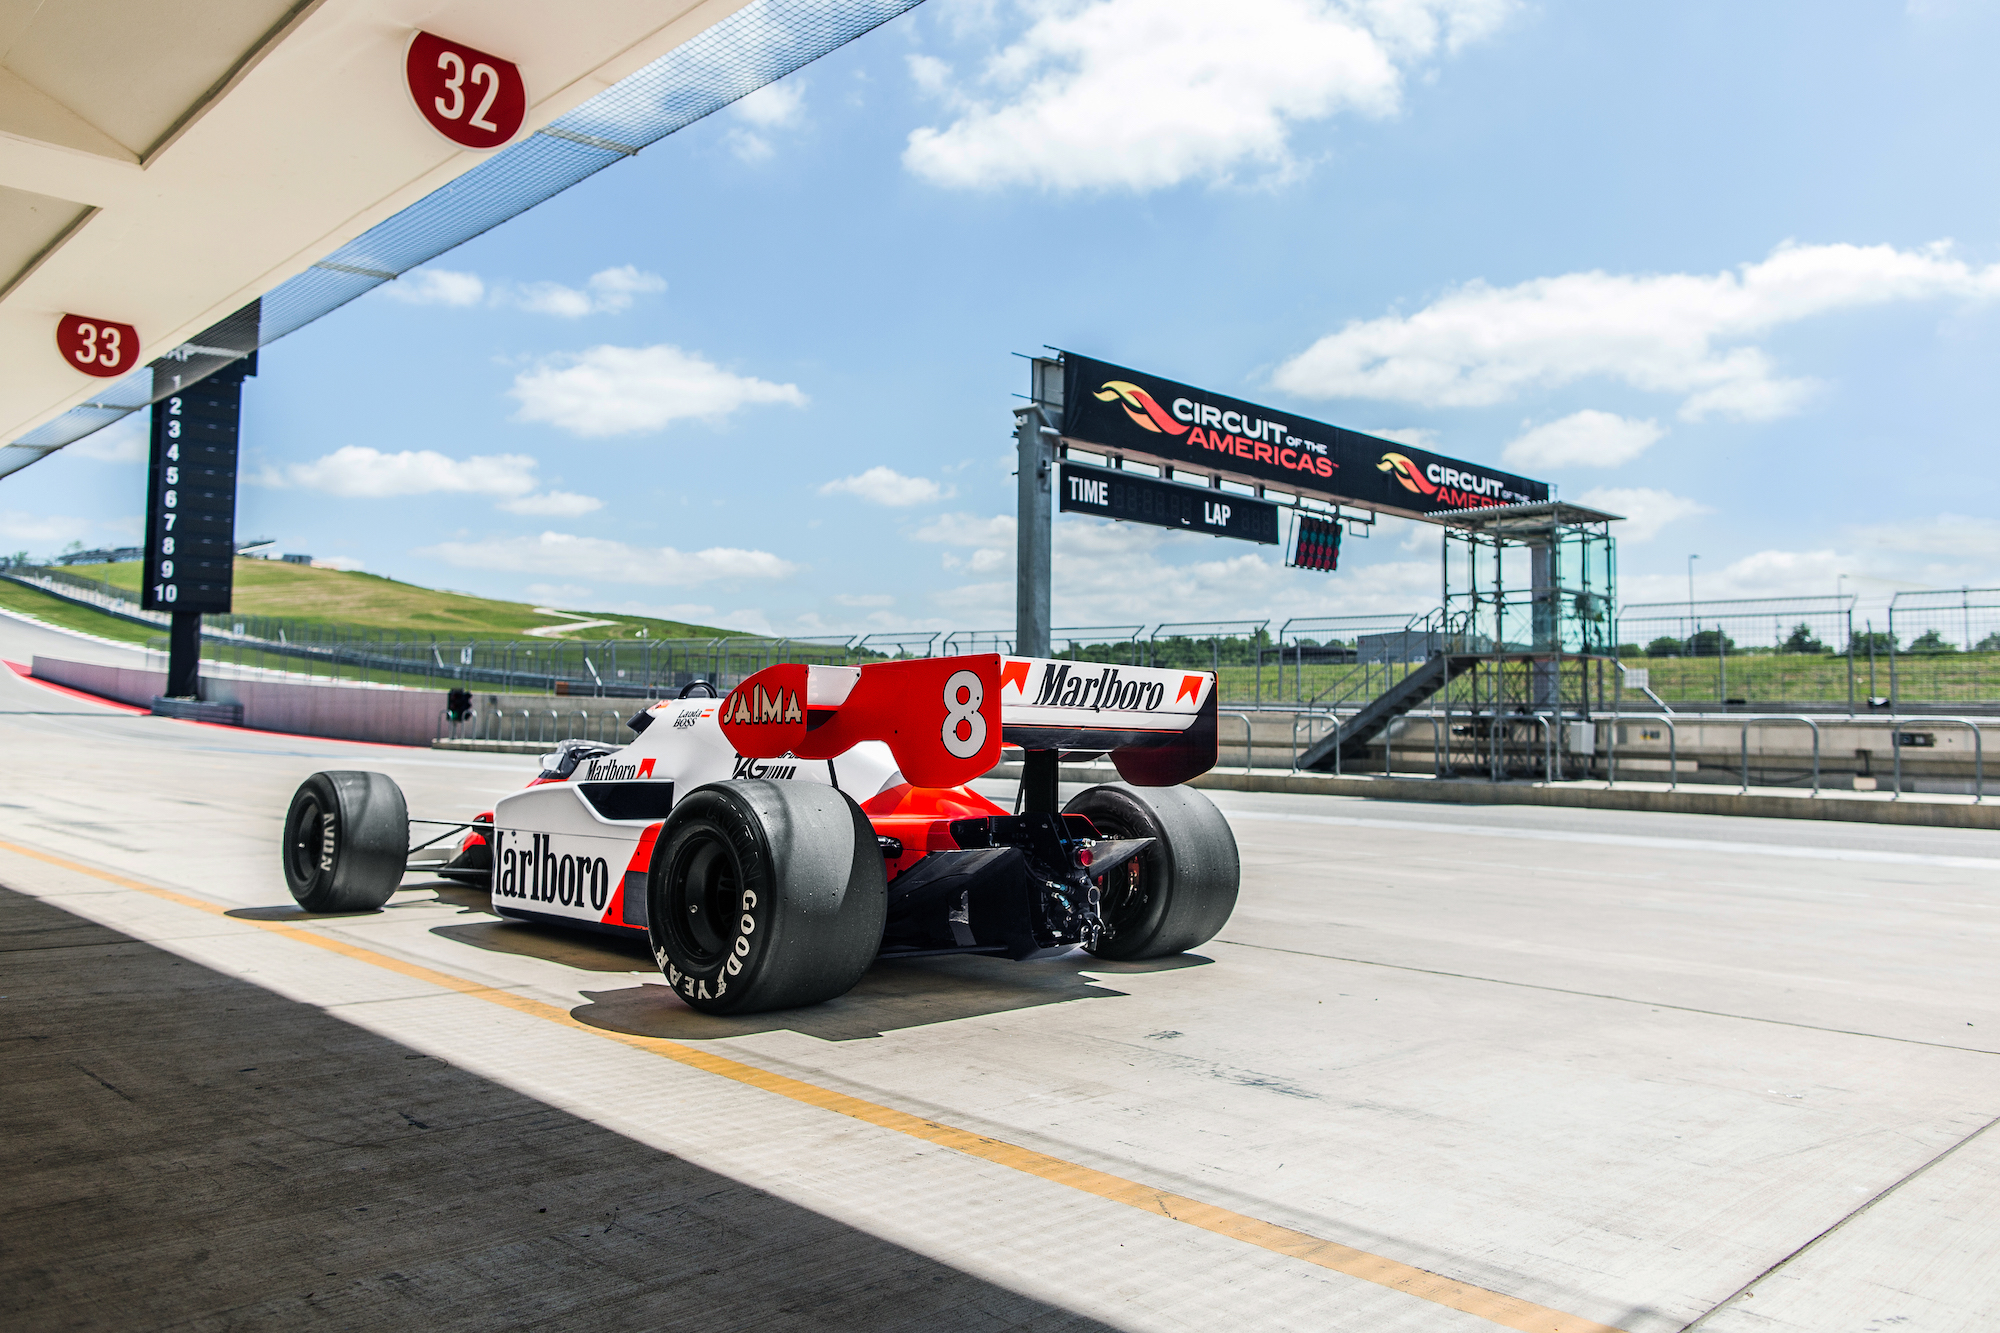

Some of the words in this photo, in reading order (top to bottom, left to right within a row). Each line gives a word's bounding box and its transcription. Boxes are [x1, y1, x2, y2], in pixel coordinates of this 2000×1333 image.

[434, 50, 500, 133] 32
[75, 322, 122, 368] 33
[171, 374, 181, 389] 1
[169, 397, 183, 415] 2
[168, 420, 181, 438] 3
[1172, 397, 1288, 445] CIRCUIT
[1285, 435, 1303, 448] OF
[1303, 440, 1328, 455] THE
[166, 443, 180, 462] 4
[1186, 426, 1334, 478] AMERICAS
[165, 466, 179, 485] 5
[1426, 463, 1504, 498] CIRCUIT
[164, 490, 178, 509] 6
[1068, 476, 1109, 507] TIME
[1204, 500, 1232, 527] LAP
[163, 513, 177, 532] 7
[162, 536, 176, 556] 8
[161, 559, 175, 579] 9
[154, 583, 178, 603] 10
[1032, 663, 1164, 711] Marlboro
[723, 682, 803, 726] SAIMA
[941, 669, 987, 759] 8
[673, 717, 698, 727] BOSS
[584, 759, 637, 781] Marlboro
[320, 813, 335, 871] AVON
[656, 889, 758, 1000] GOODYEAR
